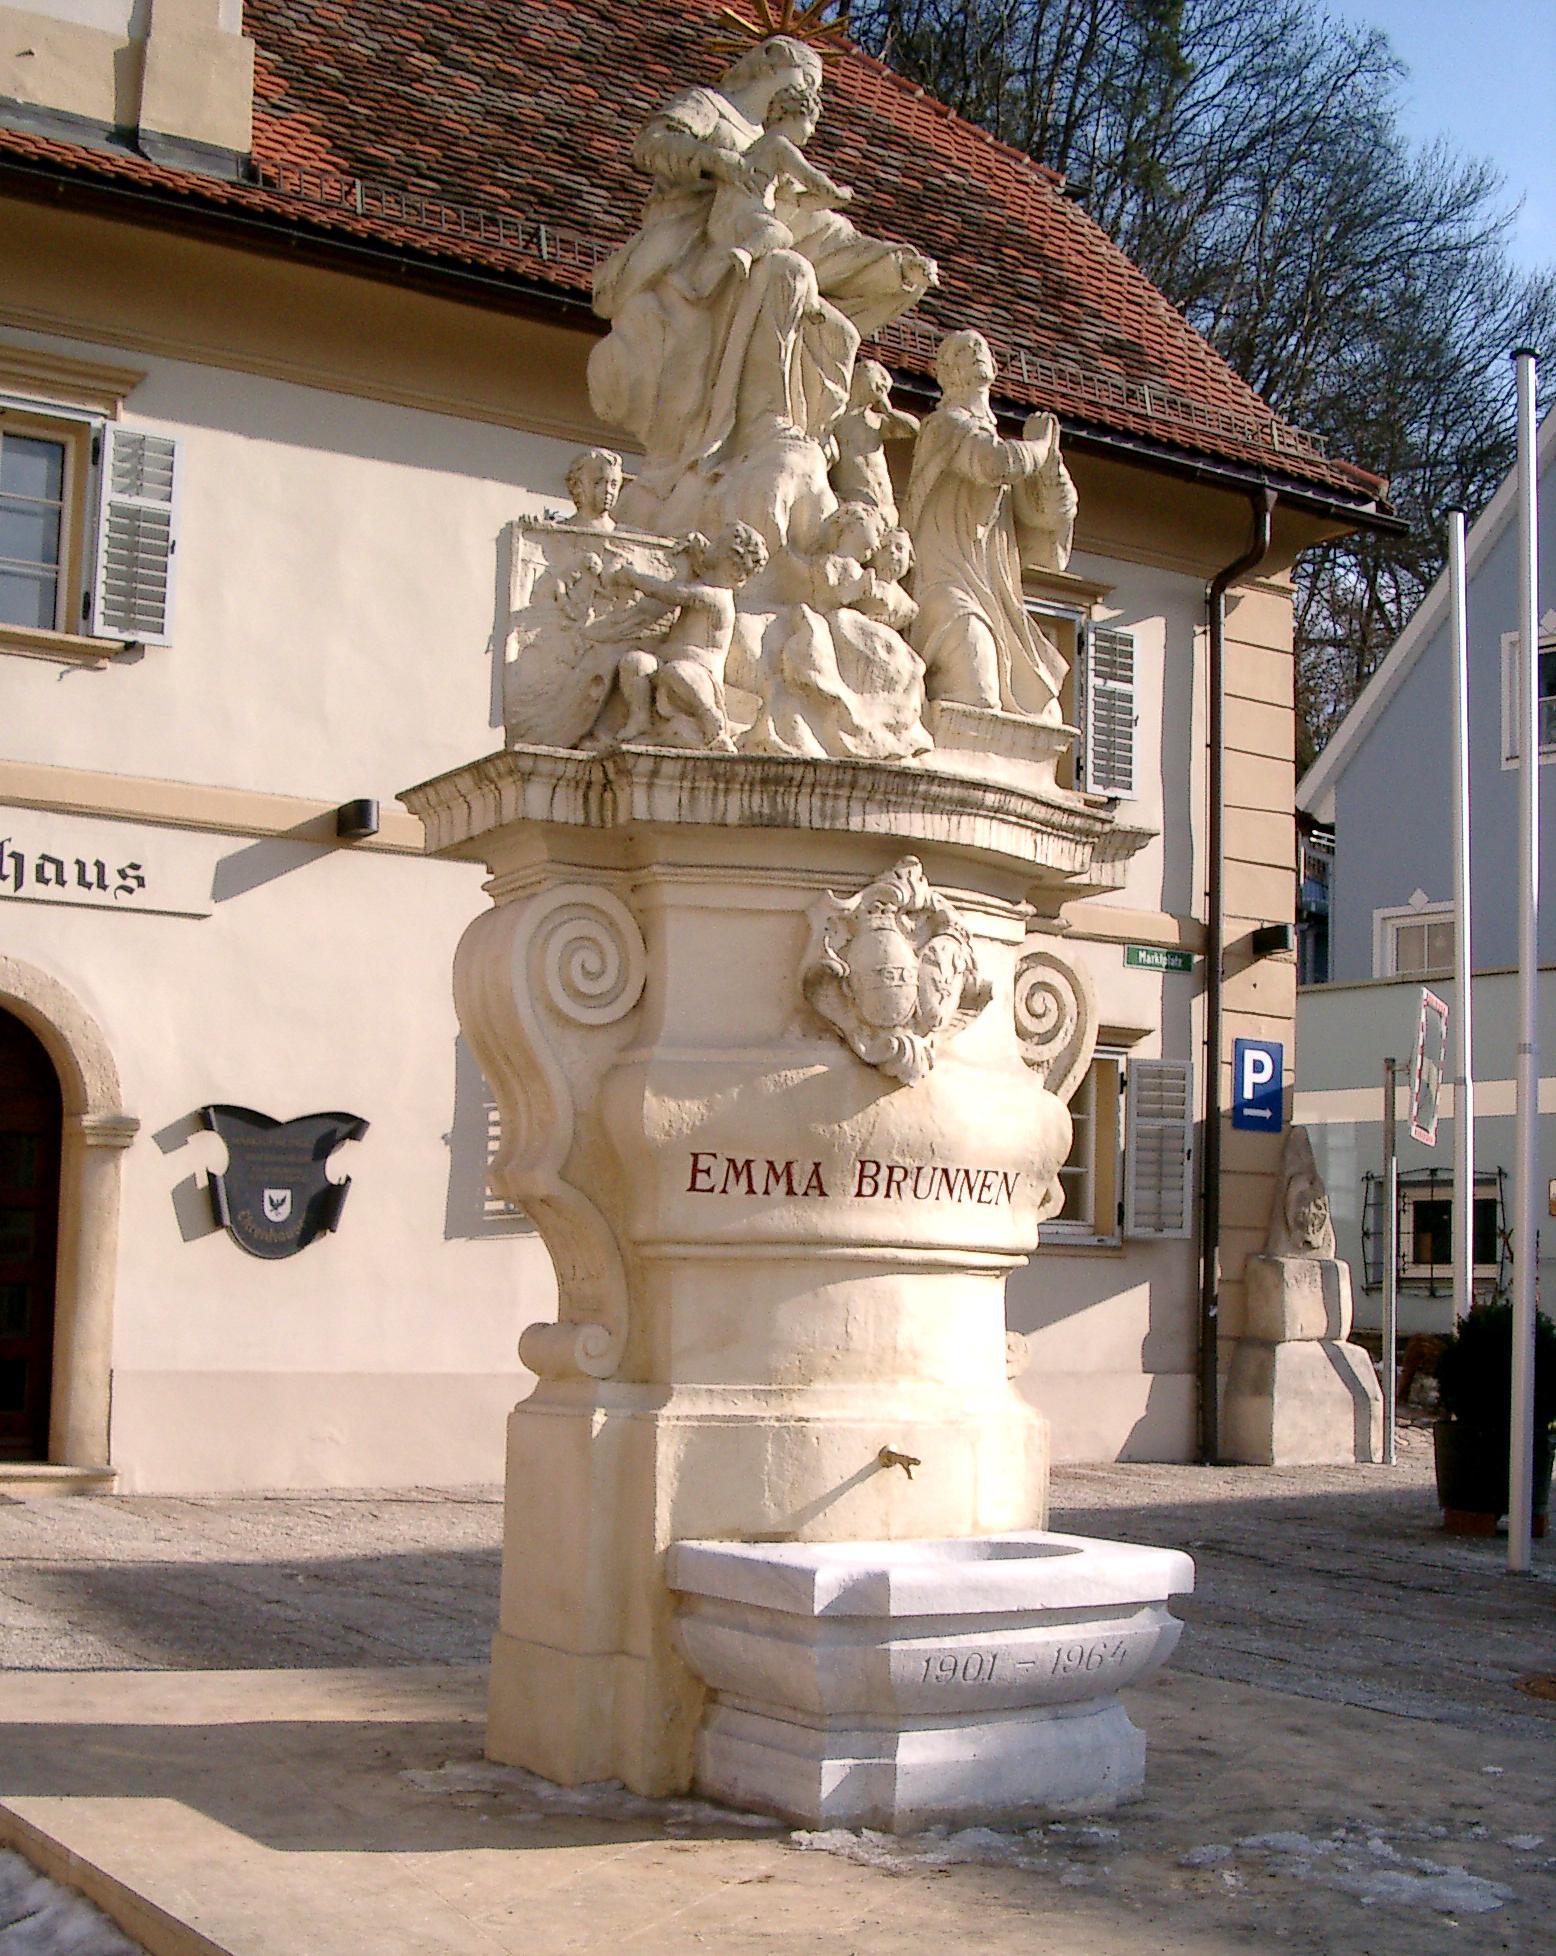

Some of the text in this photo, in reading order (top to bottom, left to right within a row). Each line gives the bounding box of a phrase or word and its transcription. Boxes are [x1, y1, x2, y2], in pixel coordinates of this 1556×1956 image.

[1243, 1049, 1274, 1100] P
[685, 1152, 1021, 1205] EMMA BRUNNEN
[922, 1652, 998, 1683] 1901
[1051, 1640, 1128, 1676] 1964
